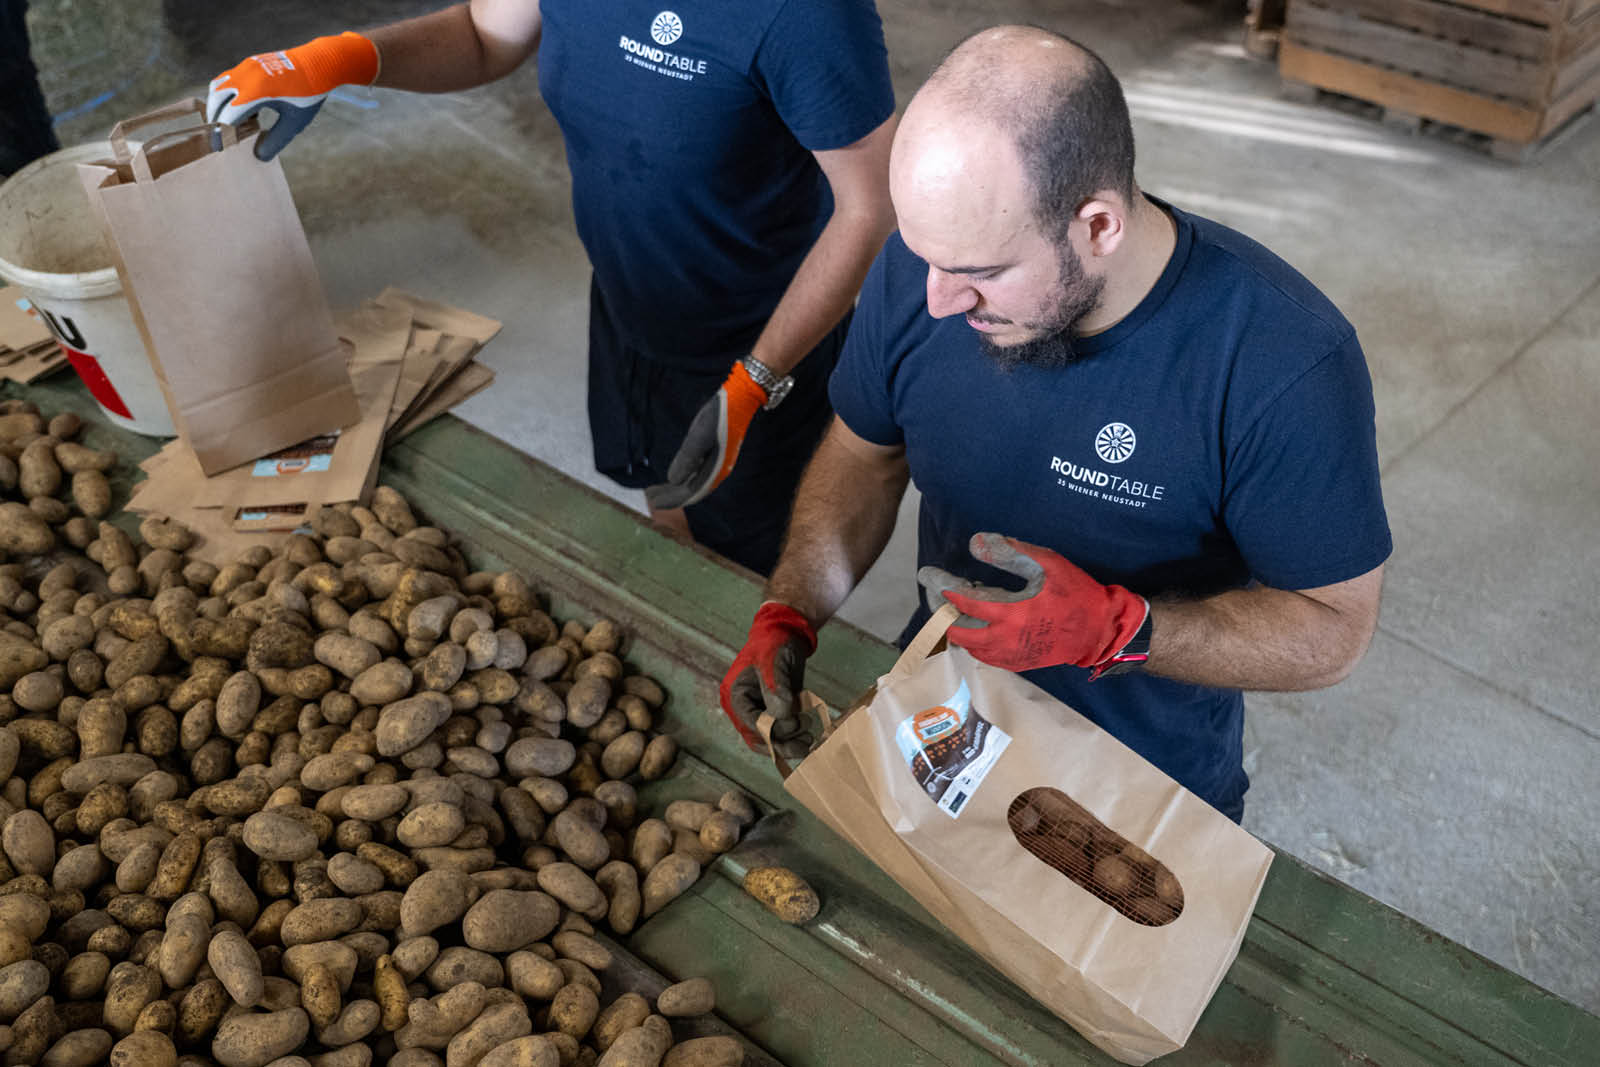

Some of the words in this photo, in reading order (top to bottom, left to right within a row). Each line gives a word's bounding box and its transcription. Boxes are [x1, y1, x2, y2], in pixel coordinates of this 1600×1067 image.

[619, 35, 707, 74] ROUNDTABLE
[658, 67, 694, 81] NEUSTADT
[1050, 456, 1165, 501] ROUNDTABLE
[1068, 482, 1099, 498] WIENER
[1102, 493, 1146, 508] NEUSTADT
